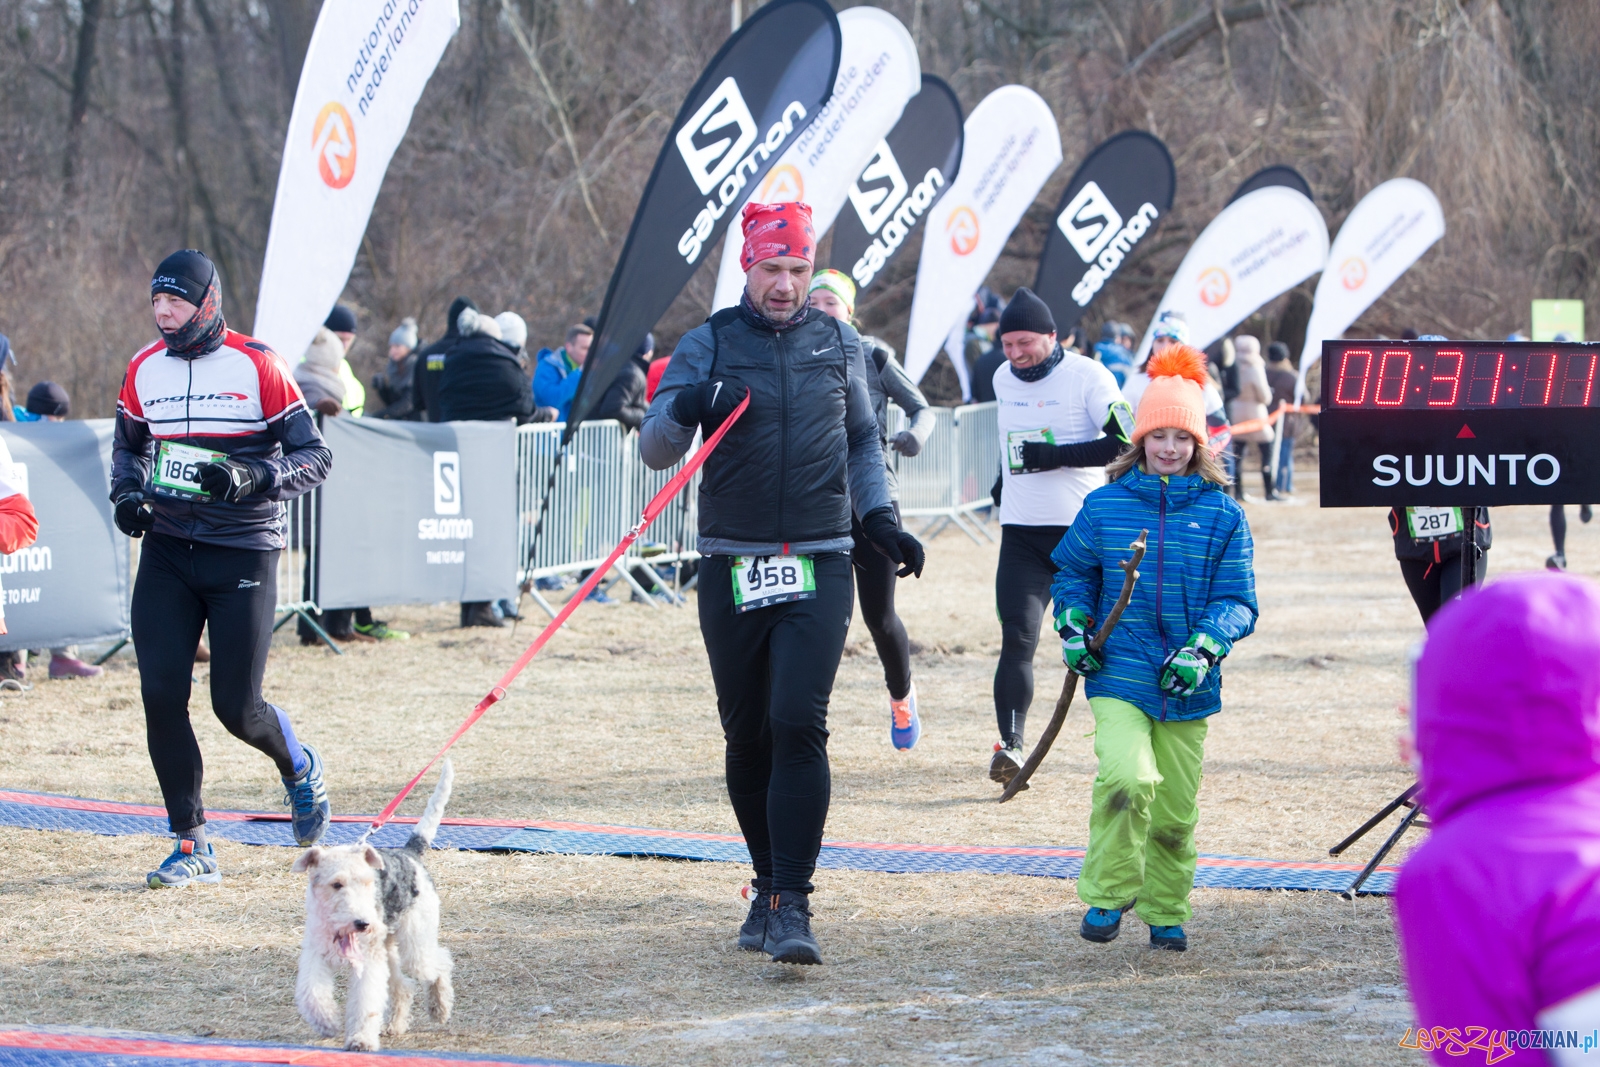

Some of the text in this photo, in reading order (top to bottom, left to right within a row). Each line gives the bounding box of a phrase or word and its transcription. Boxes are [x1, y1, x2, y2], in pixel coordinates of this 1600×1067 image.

[808, 52, 892, 168] nederlanden
[1335, 350, 1598, 406] 00:31:11
[144, 393, 233, 407] goggle
[165, 460, 197, 482] 186
[1371, 453, 1561, 486] SUUNTO
[1418, 512, 1449, 530] 287
[747, 566, 797, 591] 958
[8, 589, 20, 604] TO
[21, 587, 41, 603] PLAY
[762, 587, 785, 596] MARCIN
